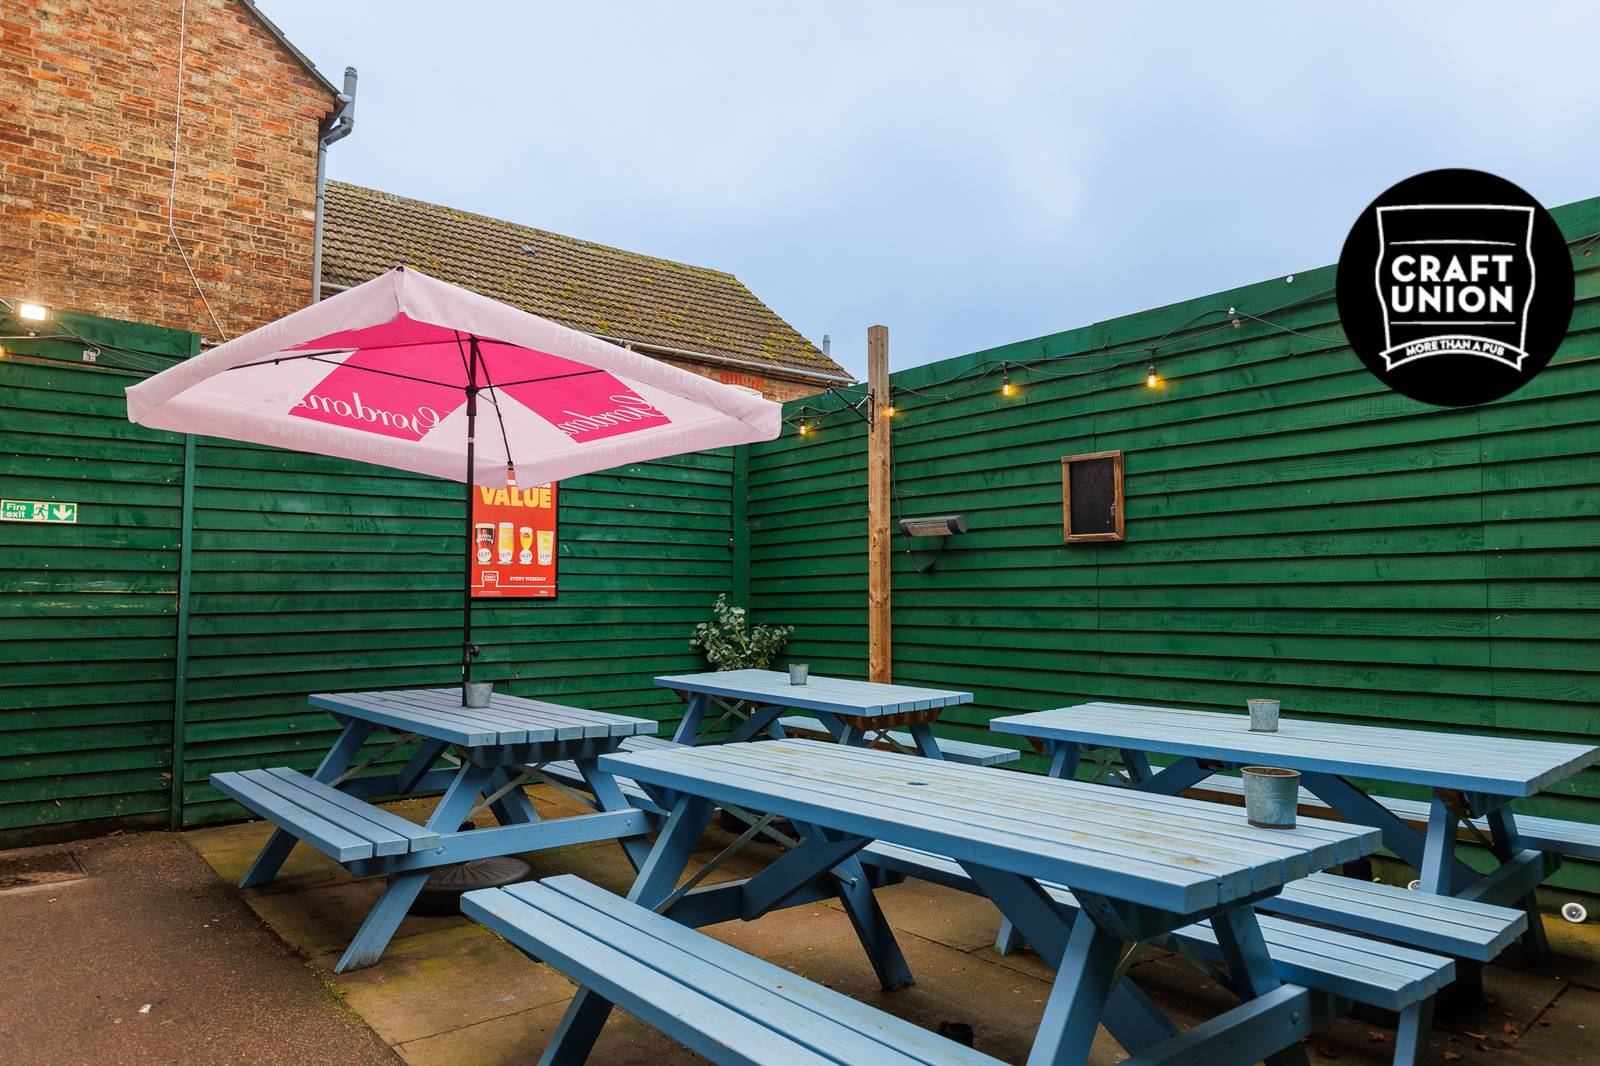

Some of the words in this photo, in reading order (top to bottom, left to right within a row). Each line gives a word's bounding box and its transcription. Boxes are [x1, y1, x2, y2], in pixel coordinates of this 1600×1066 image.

[553, 328, 655, 373] PREMIUM
[6, 503, 27, 511] Fire
[480, 485, 552, 509] VALUE
